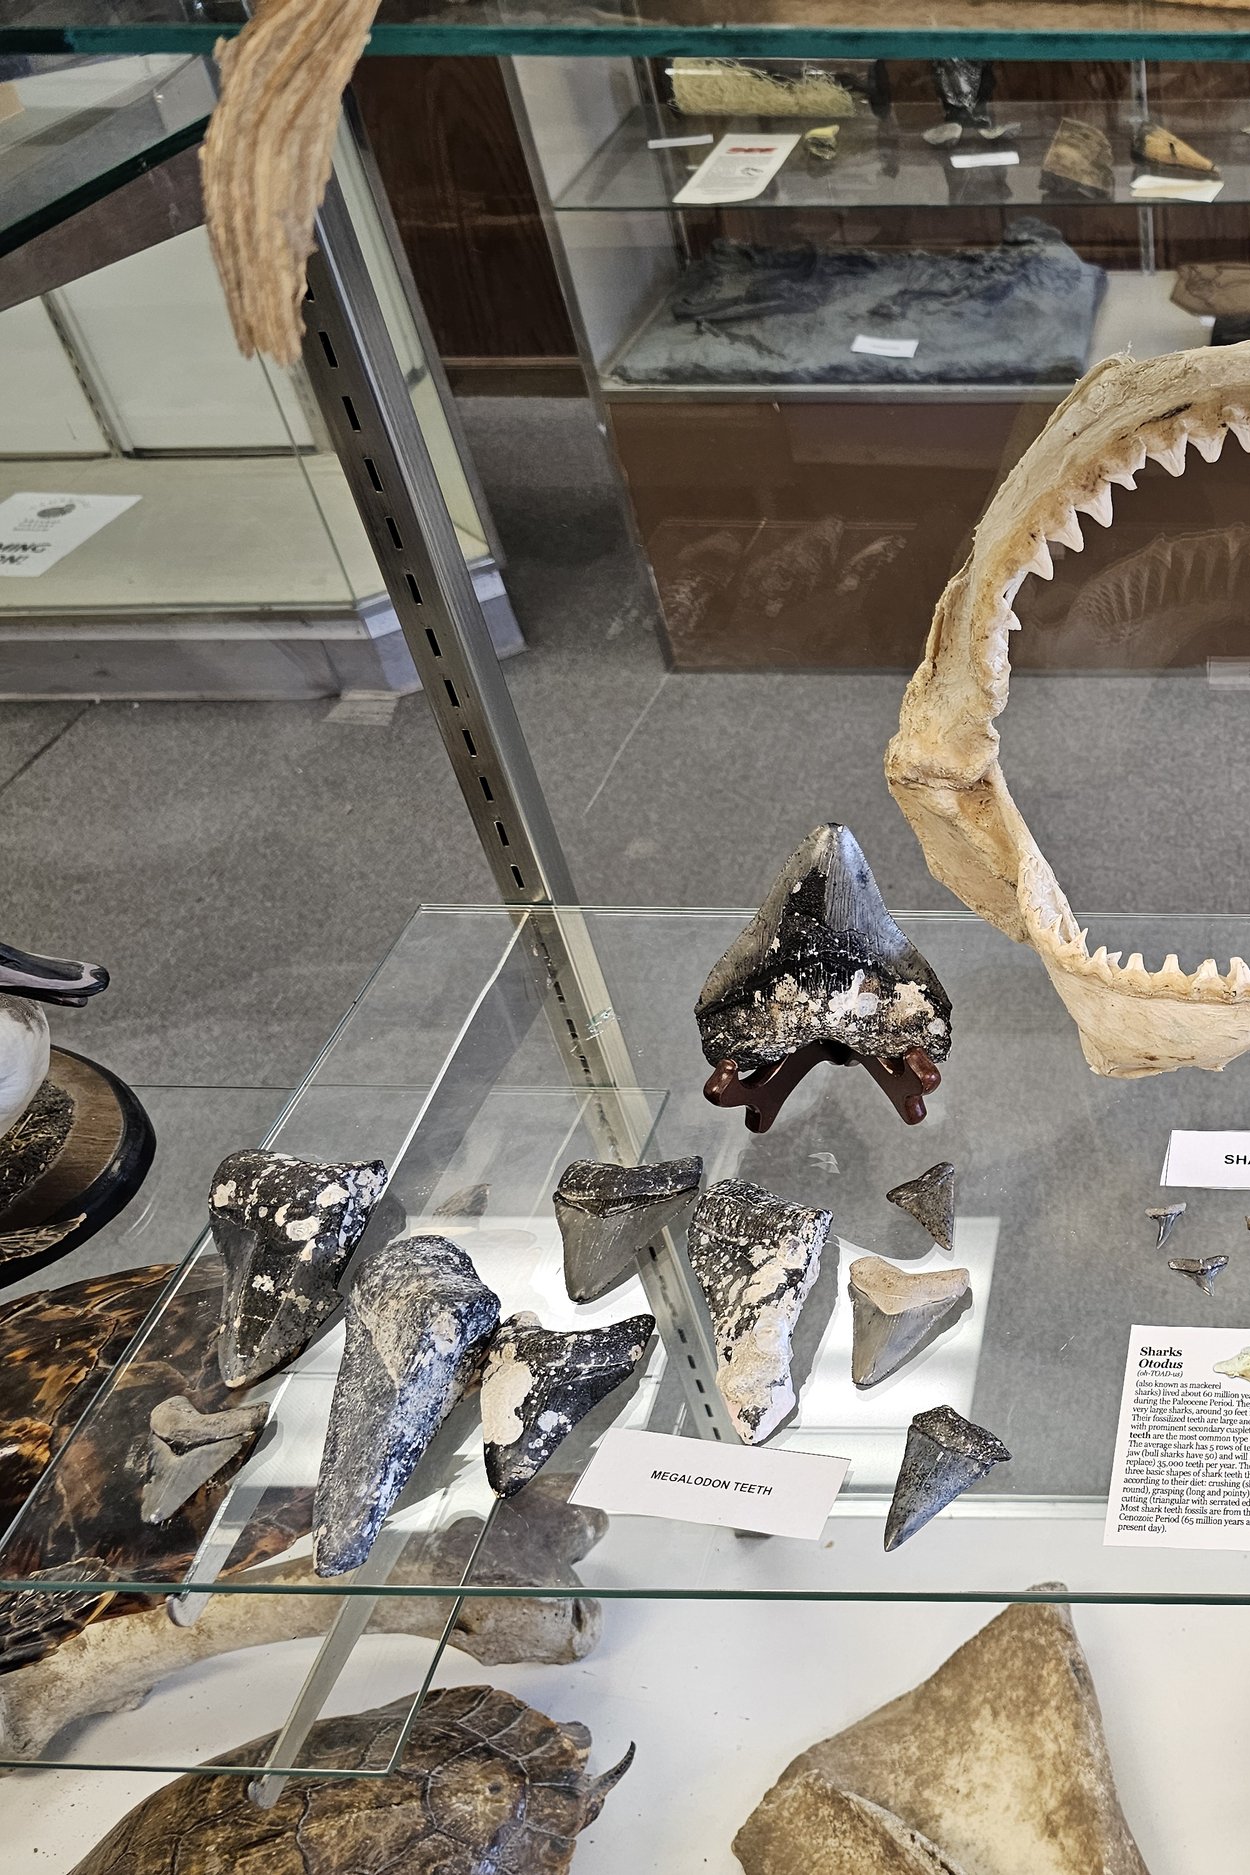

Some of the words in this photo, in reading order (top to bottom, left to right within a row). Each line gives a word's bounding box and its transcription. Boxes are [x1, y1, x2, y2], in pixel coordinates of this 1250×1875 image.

[1139, 1346, 1183, 1356] Sharks
[1138, 1358, 1183, 1368] Otodus
[1134, 1379, 1153, 1389] (also
[1154, 1379, 1179, 1387] known
[1188, 1380, 1221, 1389] mackerel
[1133, 1387, 1161, 1398] sharks)
[1162, 1388, 1180, 1396] lived
[1180, 1389, 1201, 1397] about
[1213, 1390, 1240, 1398] million
[1132, 1396, 1158, 1406] during
[1209, 1398, 1234, 1406] Period.
[1131, 1407, 1148, 1415] very
[1148, 1405, 1167, 1415] large
[1168, 1405, 1194, 1415] sharks,
[1195, 1406, 1222, 1414] around
[1234, 1407, 1247, 1415] feet
[1131, 1413, 1151, 1421] Their
[1152, 1414, 1185, 1422] fossilized
[1186, 1415, 1205, 1423] teeth
[1219, 1416, 1238, 1426] large
[1130, 1422, 1147, 1430] with
[1147, 1422, 1186, 1433] prominent
[1187, 1423, 1225, 1435] secondary
[1128, 1430, 1151, 1438] teeth
[1165, 1431, 1178, 1439] the
[1232, 1435, 1248, 1444] type
[1128, 1439, 1143, 1447] The
[1143, 1442, 1172, 1451] average
[1172, 1441, 1194, 1449] shark
[1195, 1441, 1208, 1449] has
[1209, 1444, 1214, 1452] 5
[1234, 1442, 1242, 1450] of
[1126, 1448, 1140, 1459] jaw
[1140, 1448, 1159, 1459] (bull
[1159, 1449, 1185, 1458] sharks
[1185, 1450, 1204, 1458] have
[1204, 1450, 1218, 1461] 50)
[1218, 1451, 1233, 1459] and
[1234, 1451, 1248, 1460] will
[1125, 1457, 1156, 1468] replace)
[1184, 1459, 1204, 1467] teeth
[1204, 1462, 1218, 1470] per
[1218, 1463, 1237, 1471] year.
[1124, 1466, 1145, 1474] three
[1145, 1467, 1165, 1475] basic
[1165, 1467, 1192, 1479] shapes
[1192, 1468, 1200, 1476] of
[1201, 1468, 1223, 1477] shark
[1223, 1469, 1243, 1478] teeth
[650, 1469, 730, 1491] MEGALODON
[733, 1480, 773, 1497] TEETH
[1122, 1475, 1160, 1487] according
[1170, 1477, 1189, 1485] their
[1189, 1477, 1207, 1486] diet:
[1207, 1478, 1241, 1489] crushing
[1121, 1484, 1151, 1496] round),
[1151, 1485, 1185, 1497] grasping
[1184, 1486, 1206, 1498] (long
[1206, 1487, 1221, 1495] and
[1120, 1493, 1148, 1505] cutting
[1148, 1494, 1190, 1507] (triangular
[1190, 1496, 1208, 1504] with
[1208, 1496, 1240, 1505] serrated
[1119, 1503, 1140, 1512] Most
[1140, 1503, 1163, 1512] shark
[1163, 1504, 1183, 1513] teeth
[1184, 1505, 1208, 1514] fossils
[1222, 1506, 1241, 1515] from
[1118, 1512, 1154, 1522] Cenozoic
[1154, 1513, 1180, 1523] Period
[1180, 1514, 1194, 1526] (65
[1195, 1515, 1223, 1524] million
[1223, 1519, 1244, 1528] years
[1116, 1523, 1146, 1534] present
[1146, 1523, 1167, 1534] day).
